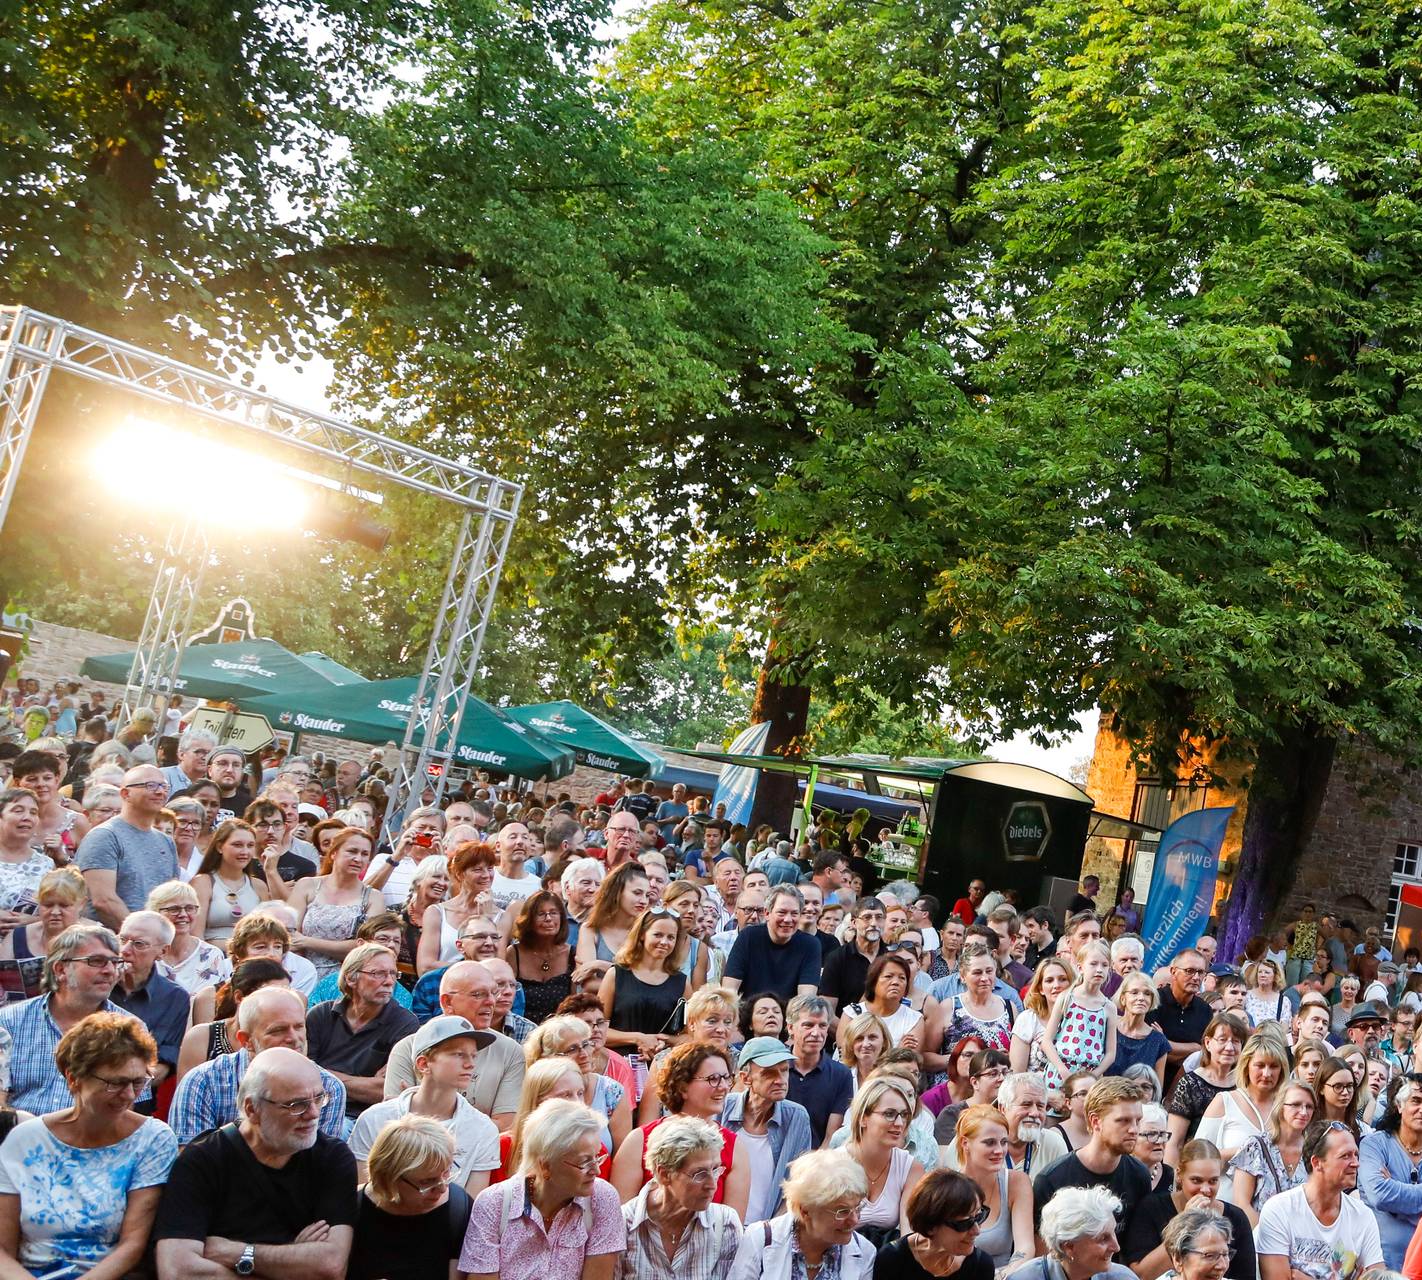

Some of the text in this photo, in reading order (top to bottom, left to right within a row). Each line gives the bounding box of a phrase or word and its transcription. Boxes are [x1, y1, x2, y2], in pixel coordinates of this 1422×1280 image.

[211, 658, 277, 679] Stauder
[204, 720, 246, 740] Toiltten
[293, 713, 345, 732] Stauder
[529, 717, 577, 734] Stauder
[457, 745, 507, 766] Stauder
[586, 752, 620, 770] Stauder
[1009, 825, 1043, 839] Diebels
[1178, 850, 1213, 869] MWB
[1149, 899, 1184, 951] Herzlich
[1150, 895, 1207, 974] willkommen!
